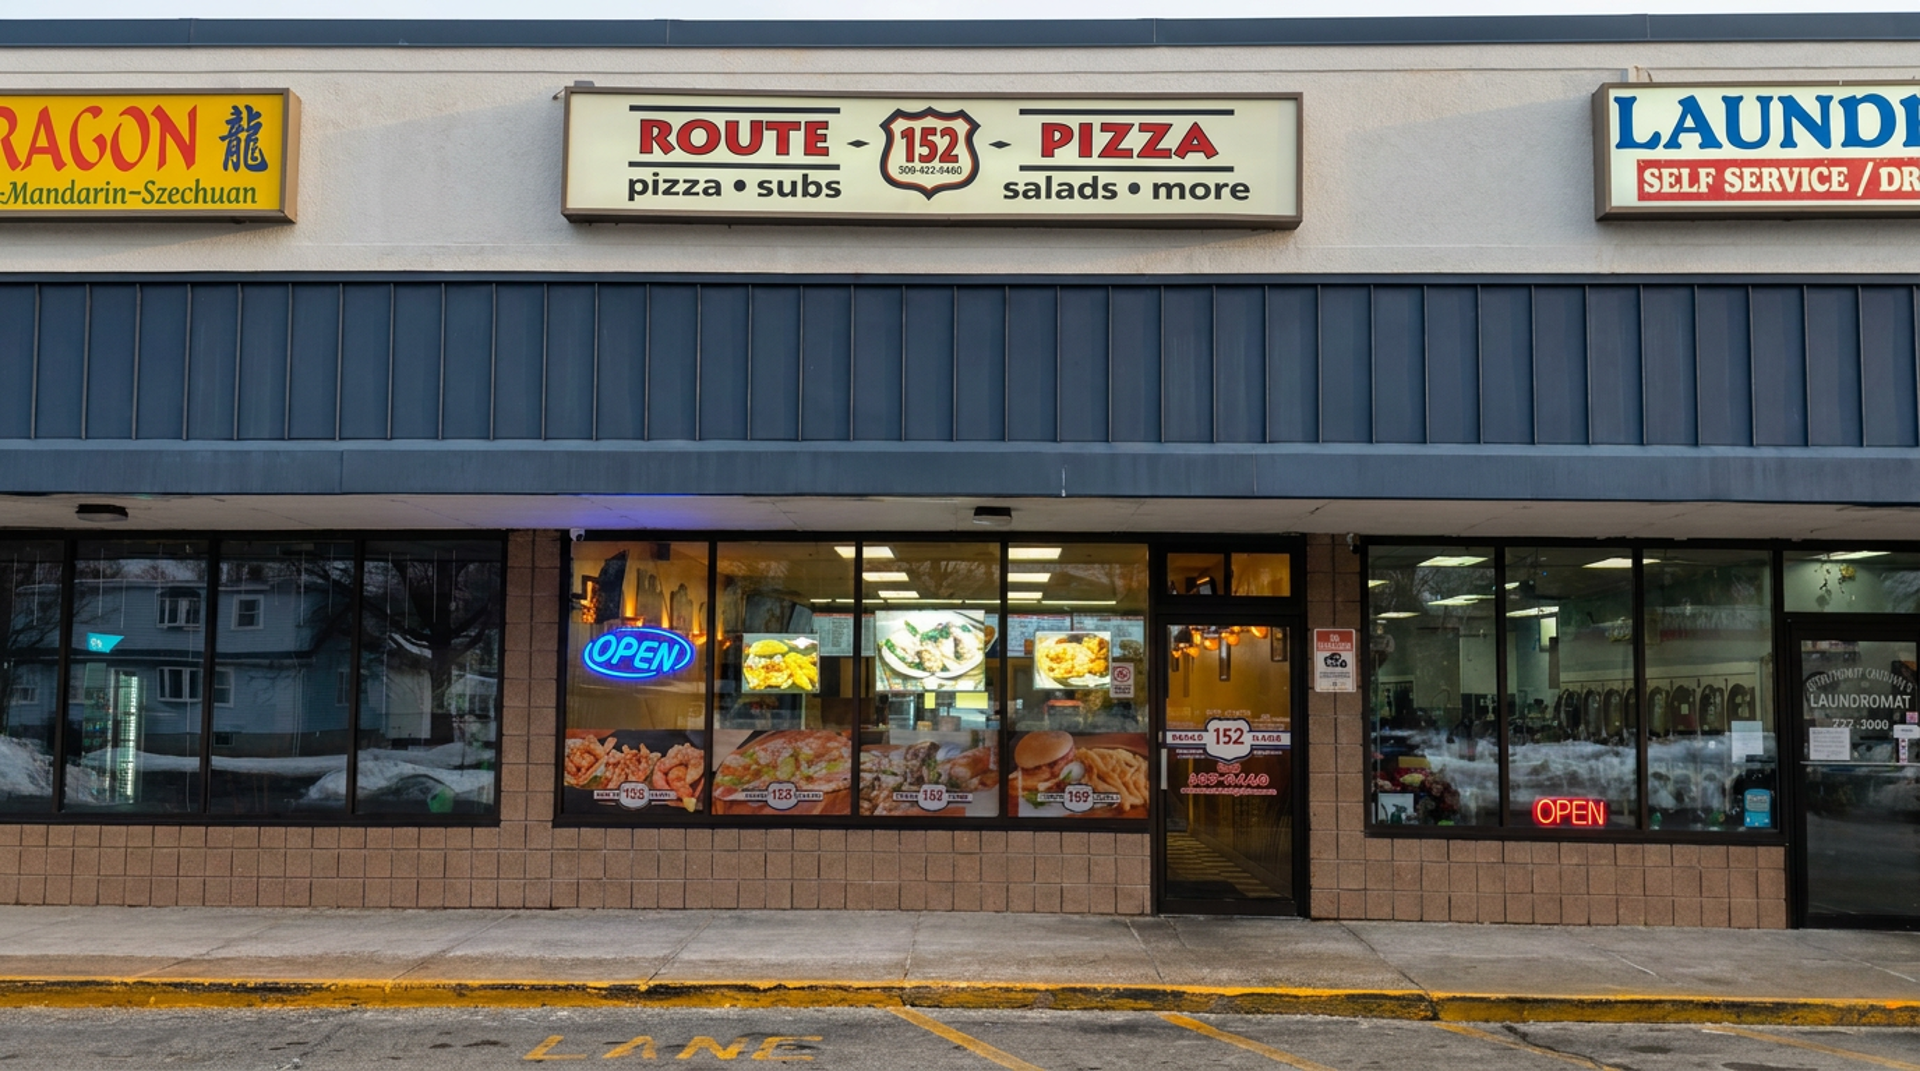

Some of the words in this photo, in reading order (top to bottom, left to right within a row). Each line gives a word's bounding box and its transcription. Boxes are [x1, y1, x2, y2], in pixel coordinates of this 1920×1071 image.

[0, 105, 197, 172] RAGON
[219, 104, 269, 172] 龍
[639, 118, 830, 157] ROUTE
[901, 126, 959, 164] 152
[1040, 121, 1219, 160] PIZZA
[628, 172, 722, 202] pizza
[757, 173, 842, 199] subs
[1003, 174, 1118, 200] salads
[1152, 181, 1251, 201] more
[1643, 167, 1716, 194] SELF
[1723, 166, 1850, 194] SERVICE
[1878, 166, 1920, 193] DR
[591, 634, 682, 673] OPEN
[1810, 693, 1912, 709] LAUNDROMAT
[1213, 727, 1245, 746] 152
[1537, 797, 1605, 825] OPEN
[522, 1035, 823, 1061] LANE
